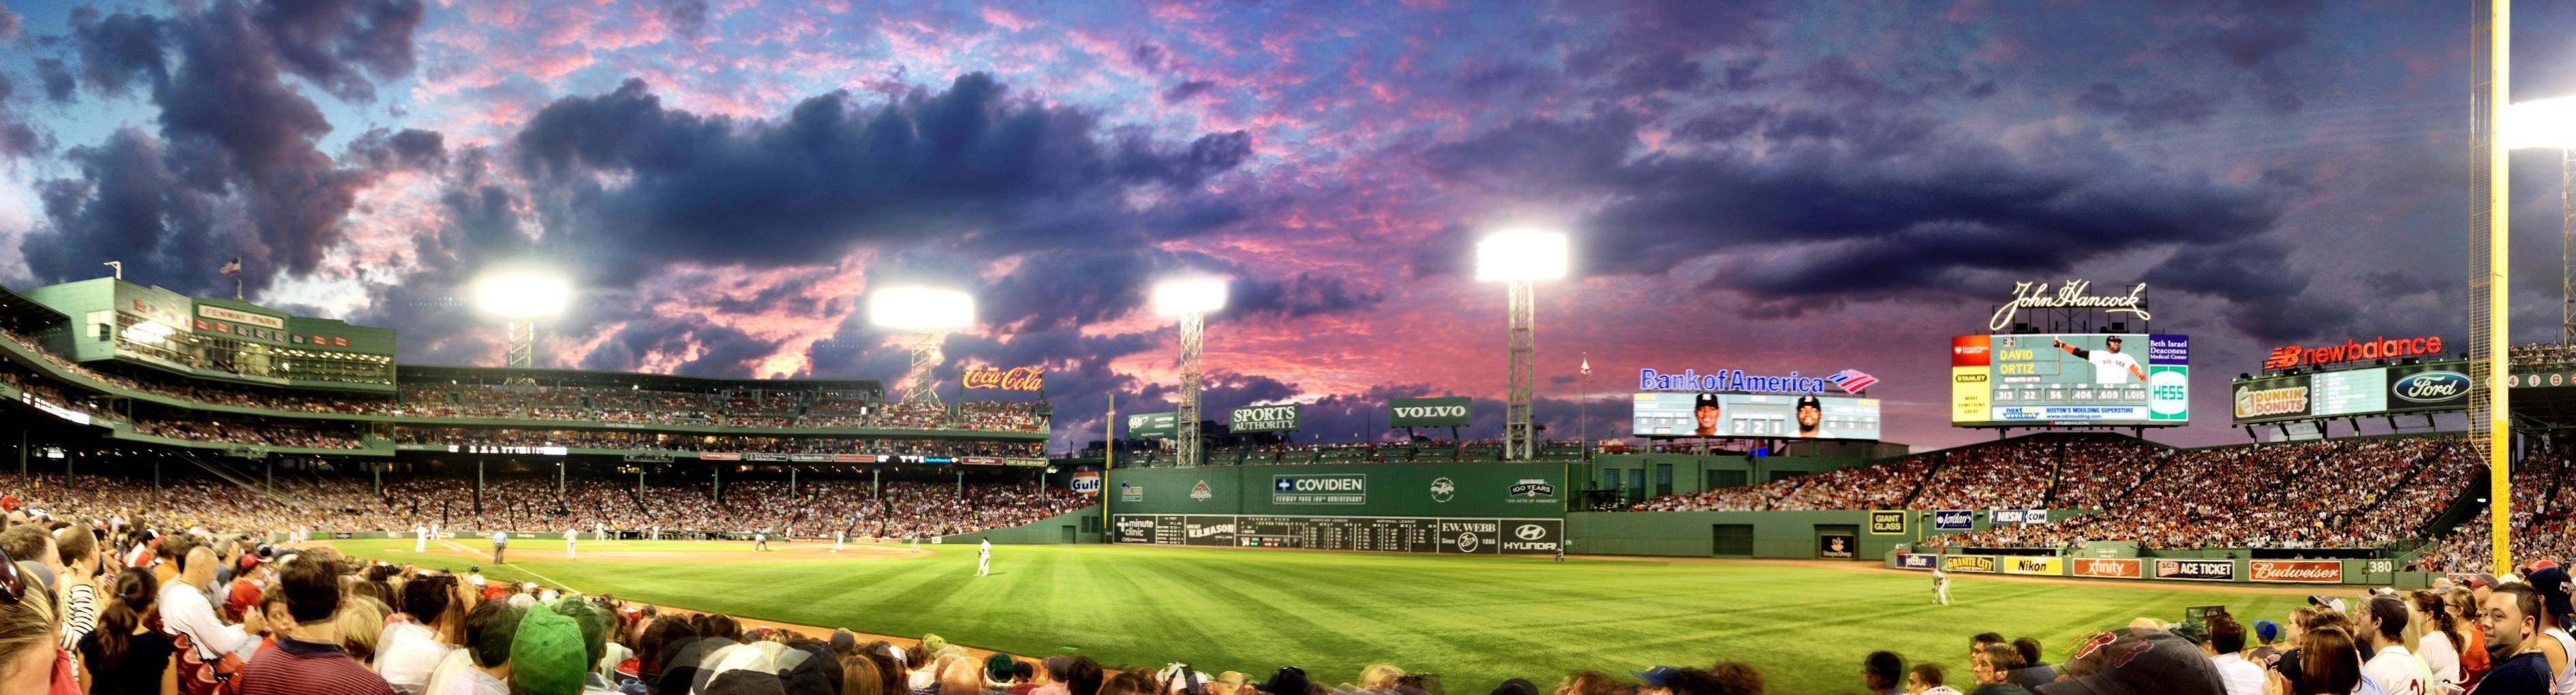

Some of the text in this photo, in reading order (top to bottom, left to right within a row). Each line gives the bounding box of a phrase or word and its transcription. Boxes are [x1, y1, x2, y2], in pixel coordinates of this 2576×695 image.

[1990, 279, 2151, 330] John Hancock
[2000, 350, 2034, 360] DAVID
[2000, 364, 2034, 374] ORTIZ
[1640, 369, 1824, 393] Bank of America
[2408, 376, 2459, 397] Ford
[1995, 391, 2013, 400] .313
[2024, 391, 2036, 399] 22
[2050, 391, 2061, 399] 56
[2072, 391, 2092, 399] .406
[2098, 391, 2119, 399] .609
[2153, 386, 2183, 400] HESS
[2256, 389, 2306, 403] DUNKIN'
[1394, 405, 1467, 418] VOLVO
[2256, 400, 2303, 413] DONUTS
[1234, 406, 1295, 422] SPORTS
[1234, 420, 1294, 431] AUTHORITY
[1735, 422, 1745, 433] 2
[1753, 422, 1764, 433] 2
[1073, 479, 1099, 490] Gulf
[1295, 479, 1362, 491] COVIDIEN
[1527, 484, 1550, 493] YEARS
[1942, 512, 1972, 528] Jordan's
[1997, 511, 2023, 522] NESN
[1129, 519, 1154, 528] minute
[1466, 523, 1496, 533] WEBB
[1125, 528, 1144, 537] clinic
[1504, 542, 1557, 550] HYUNDAI
[1905, 555, 1927, 567] jetBlue
[1947, 557, 1976, 568] GRANITE
[1977, 557, 1994, 570] CITY
[2019, 560, 2046, 572] Nikon
[2370, 561, 2392, 572] 380
[2088, 560, 2124, 576] xfinity
[2181, 563, 2231, 575] ACE TICKET
[2252, 562, 2338, 579] Budweiser
